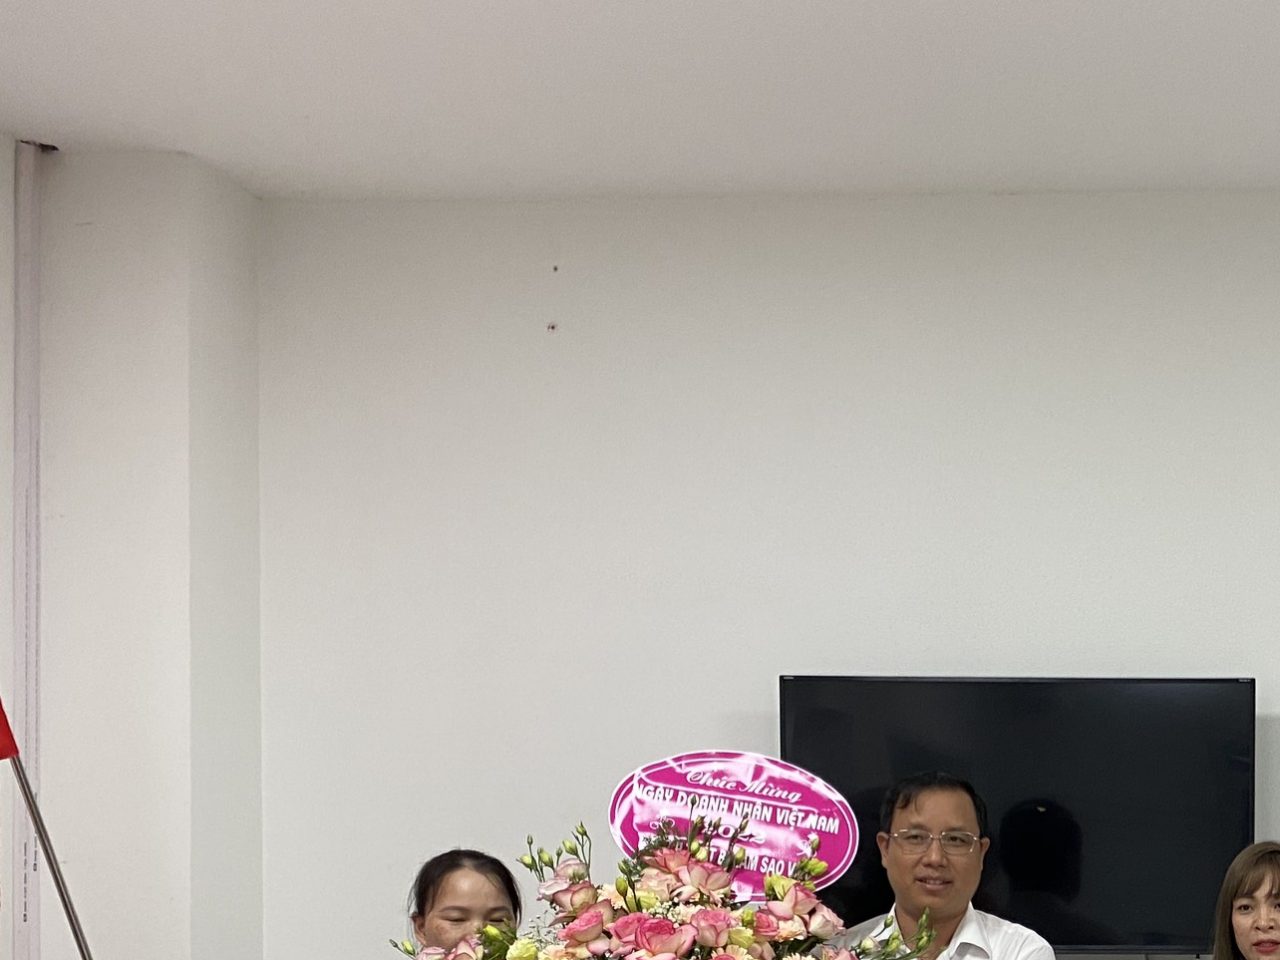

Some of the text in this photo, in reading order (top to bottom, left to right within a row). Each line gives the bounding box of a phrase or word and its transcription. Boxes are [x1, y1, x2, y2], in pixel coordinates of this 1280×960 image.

[676, 790, 730, 814] DOANH
[732, 798, 773, 823] NHÂN
[776, 806, 805, 831] VIỆT
[805, 811, 840, 835] NAM
[760, 856, 785, 876] SAO
